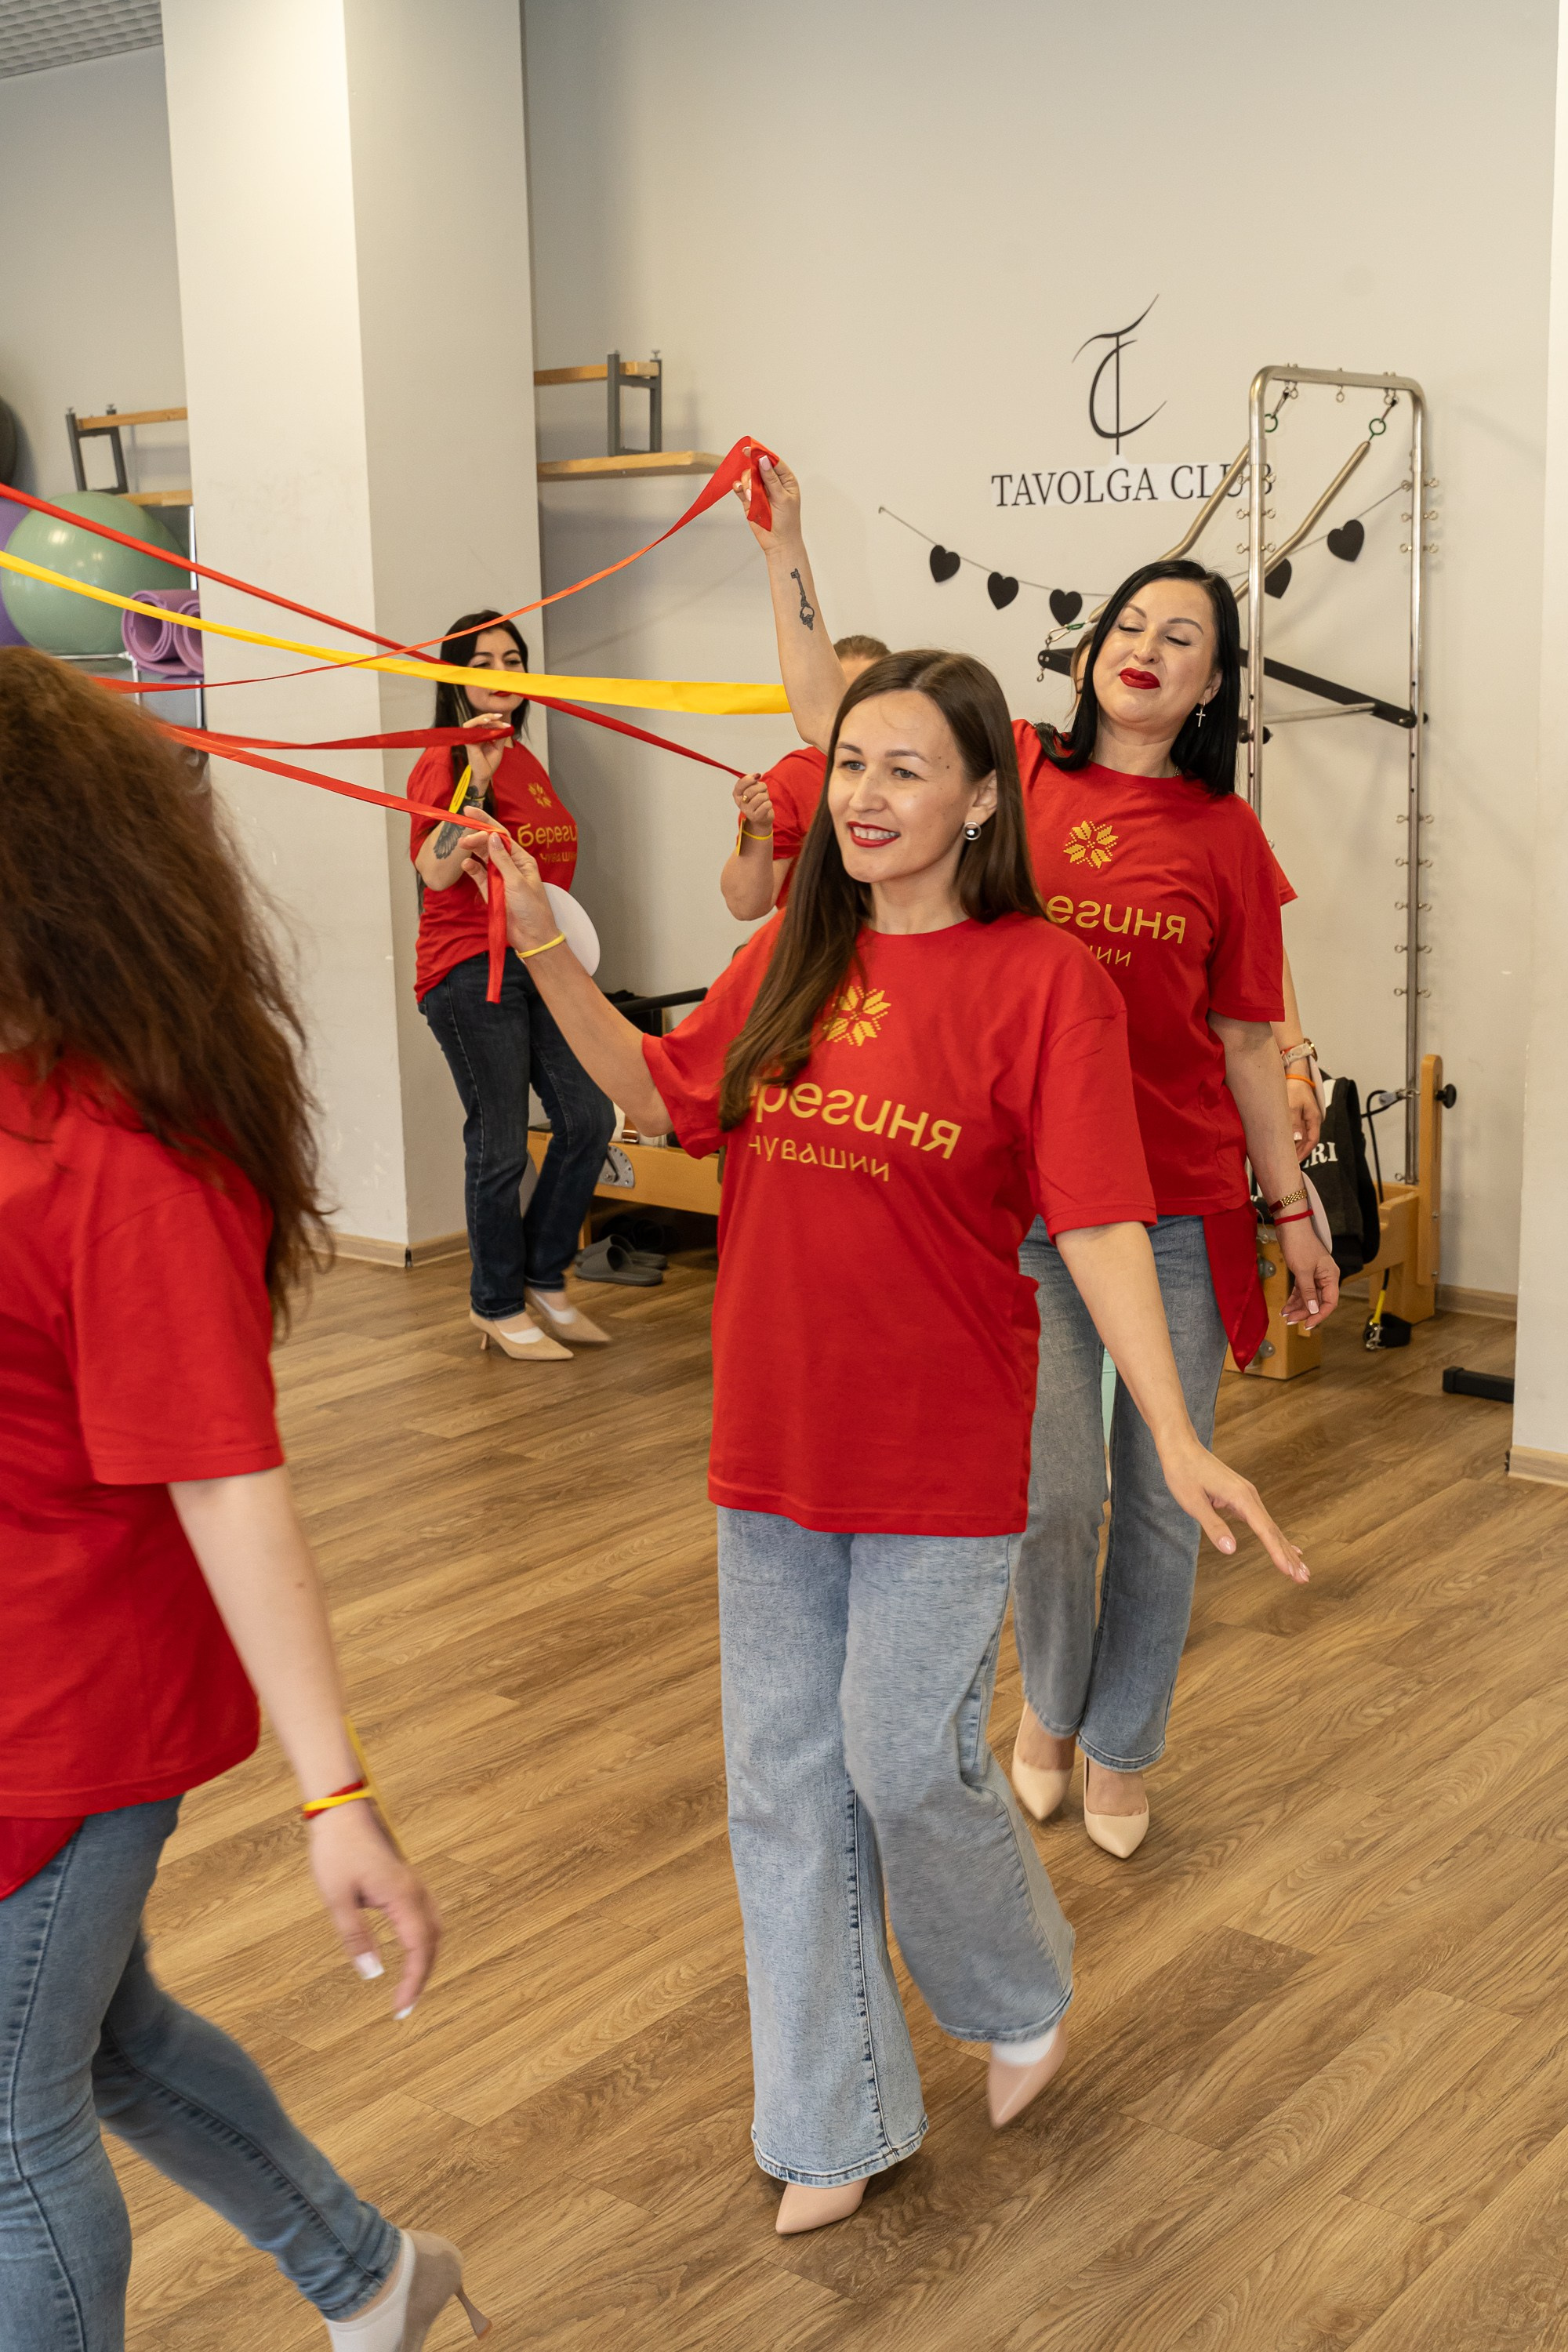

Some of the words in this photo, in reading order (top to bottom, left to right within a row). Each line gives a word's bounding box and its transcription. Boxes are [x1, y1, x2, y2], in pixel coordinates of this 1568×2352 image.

[991, 466, 1158, 507] TAVOLGA
[517, 822, 578, 849] береги
[1046, 895, 1186, 944] егиня
[750, 1082, 962, 1160] региня
